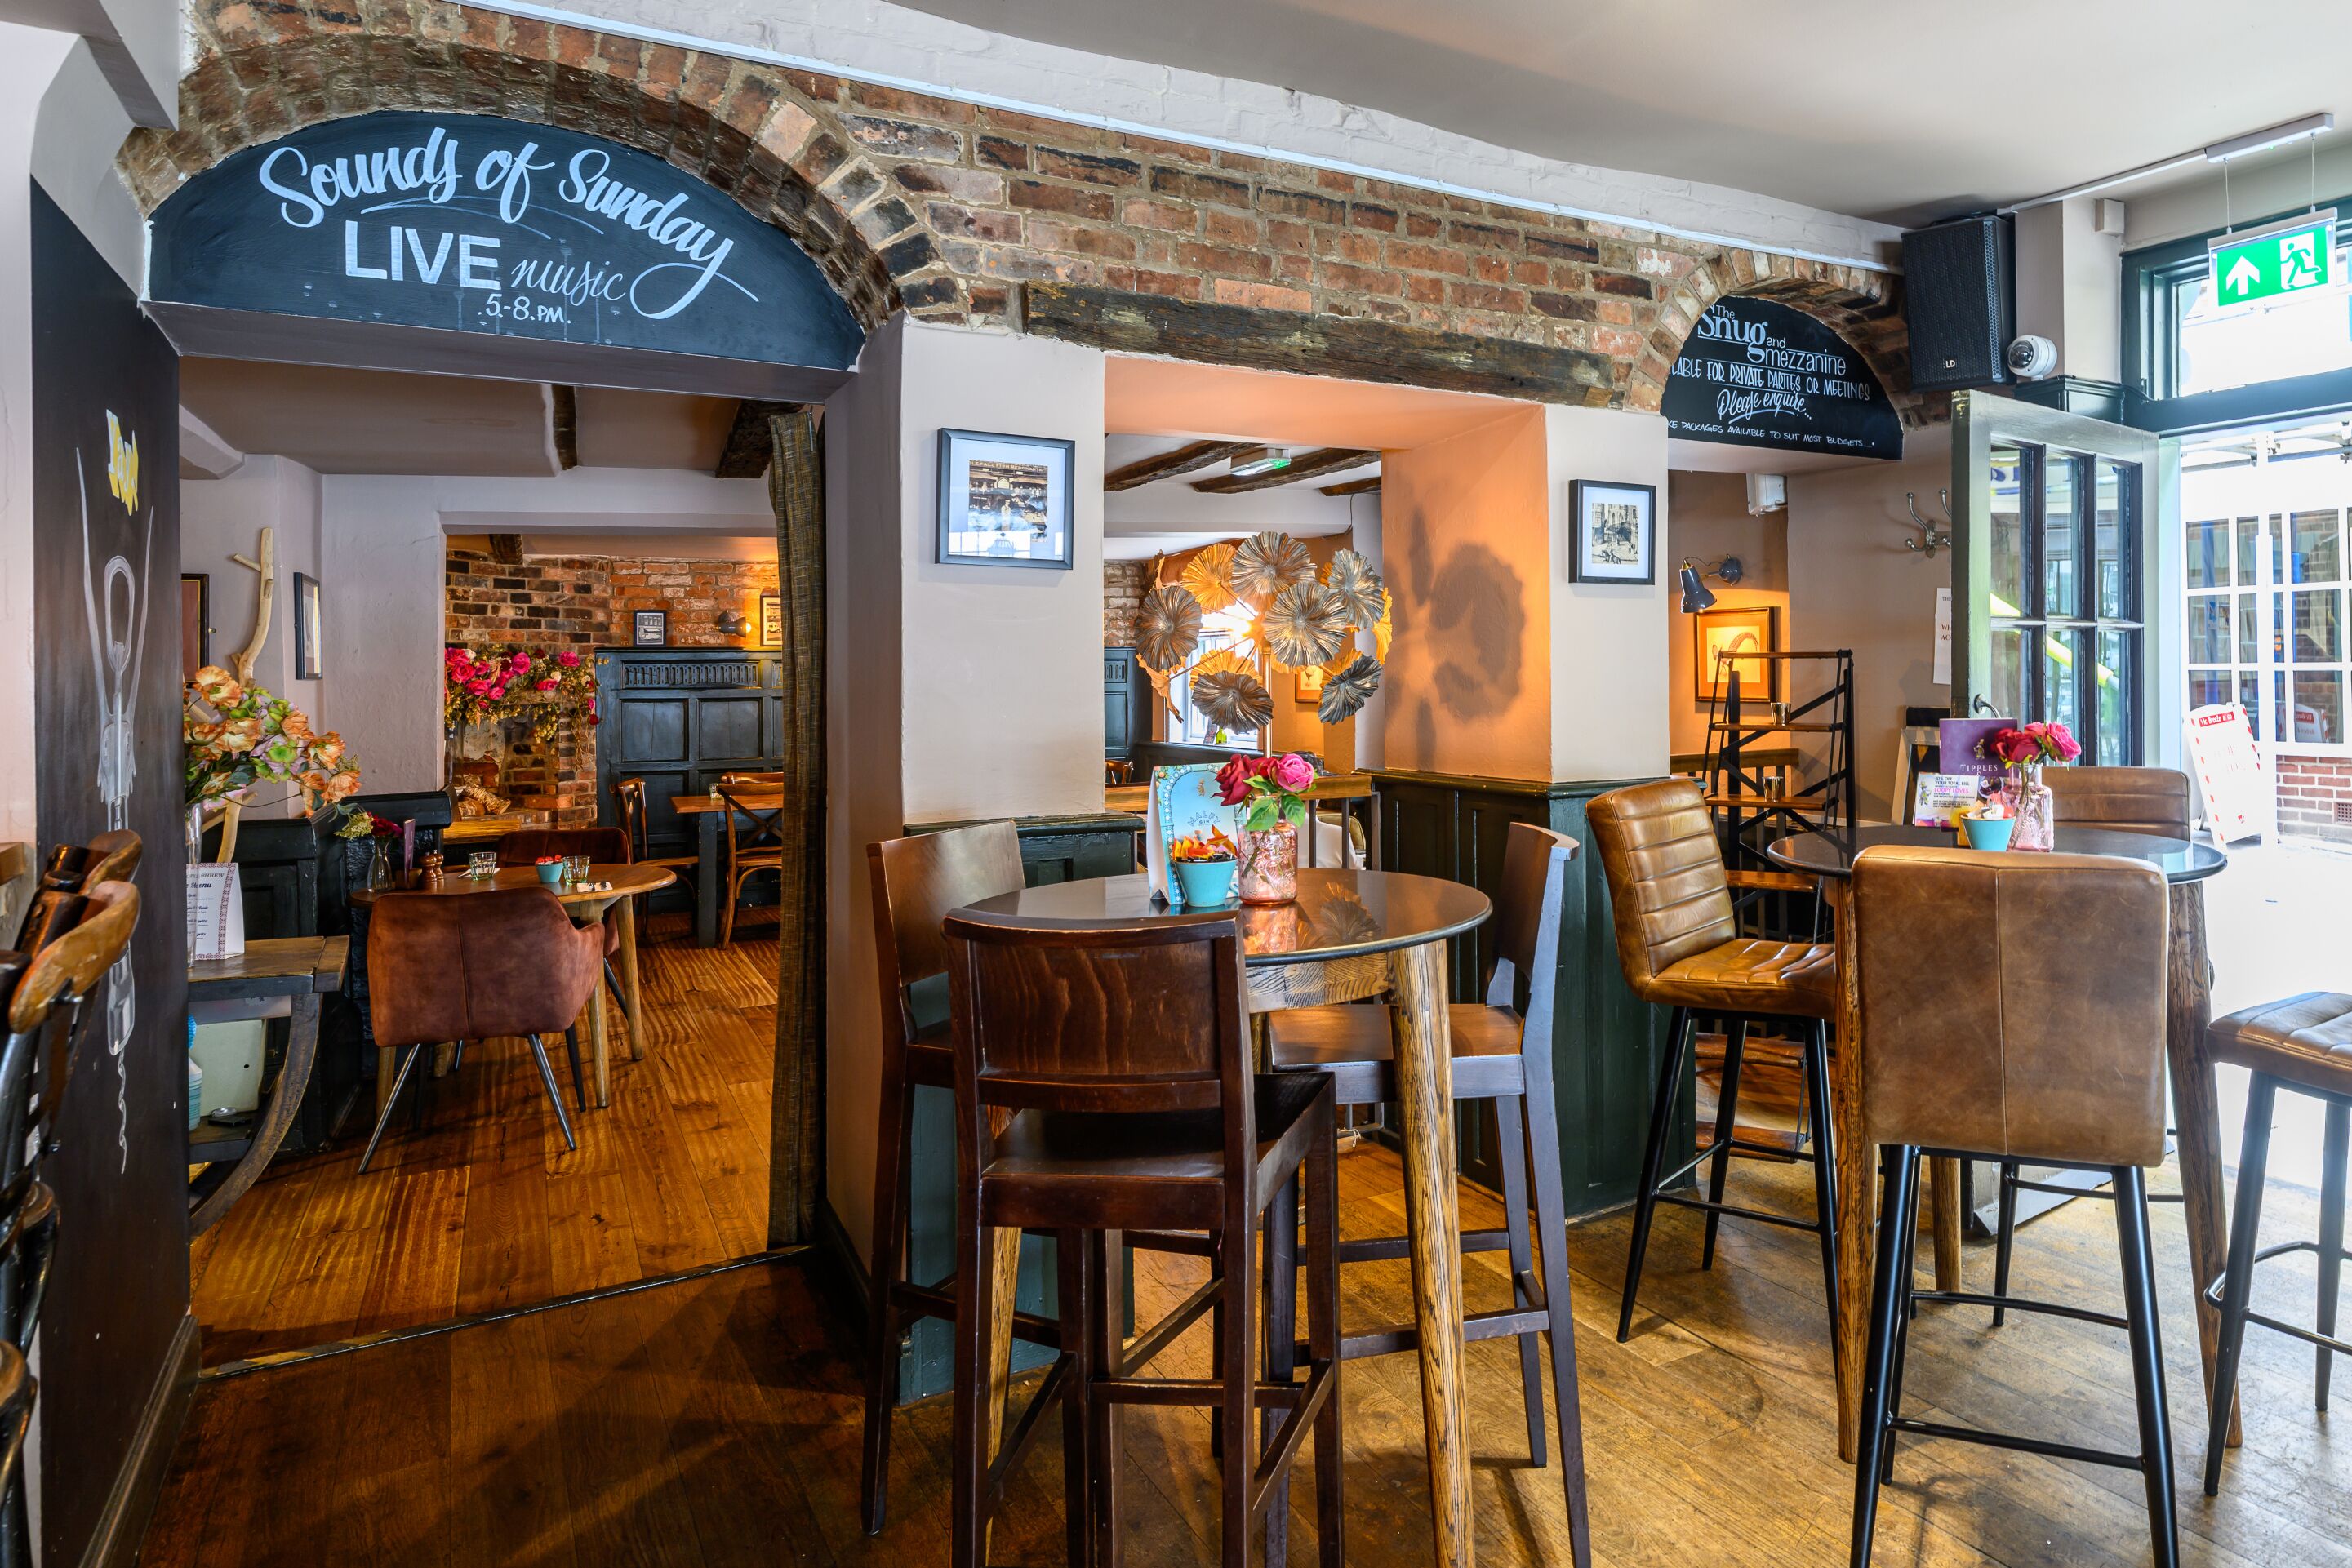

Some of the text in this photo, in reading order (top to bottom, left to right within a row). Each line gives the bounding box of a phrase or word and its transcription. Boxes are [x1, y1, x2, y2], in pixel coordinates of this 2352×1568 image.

[259, 127, 760, 319] Sounds of Sunday
[345, 220, 626, 307] LIVE music
[1716, 304, 1736, 319] The
[1697, 304, 1786, 364] Snug and
[1765, 348, 1846, 375] mezzanine
[1945, 360, 1956, 368] LD
[1706, 361, 1725, 382] FOR
[1730, 362, 1764, 387] PRIVATE
[1767, 369, 1801, 392] PARTIES
[1806, 376, 1820, 394] OR
[1823, 379, 1870, 401] MEETINGS
[1717, 389, 1761, 420] Please
[1681, 421, 1723, 433] PACKAGES
[1727, 425, 1765, 438] AVAILABLE
[1770, 430, 1781, 440] TO
[1783, 432, 1801, 441] SUIT
[1803, 434, 1822, 443] MOST
[1960, 764, 1998, 772] TIPPLES
